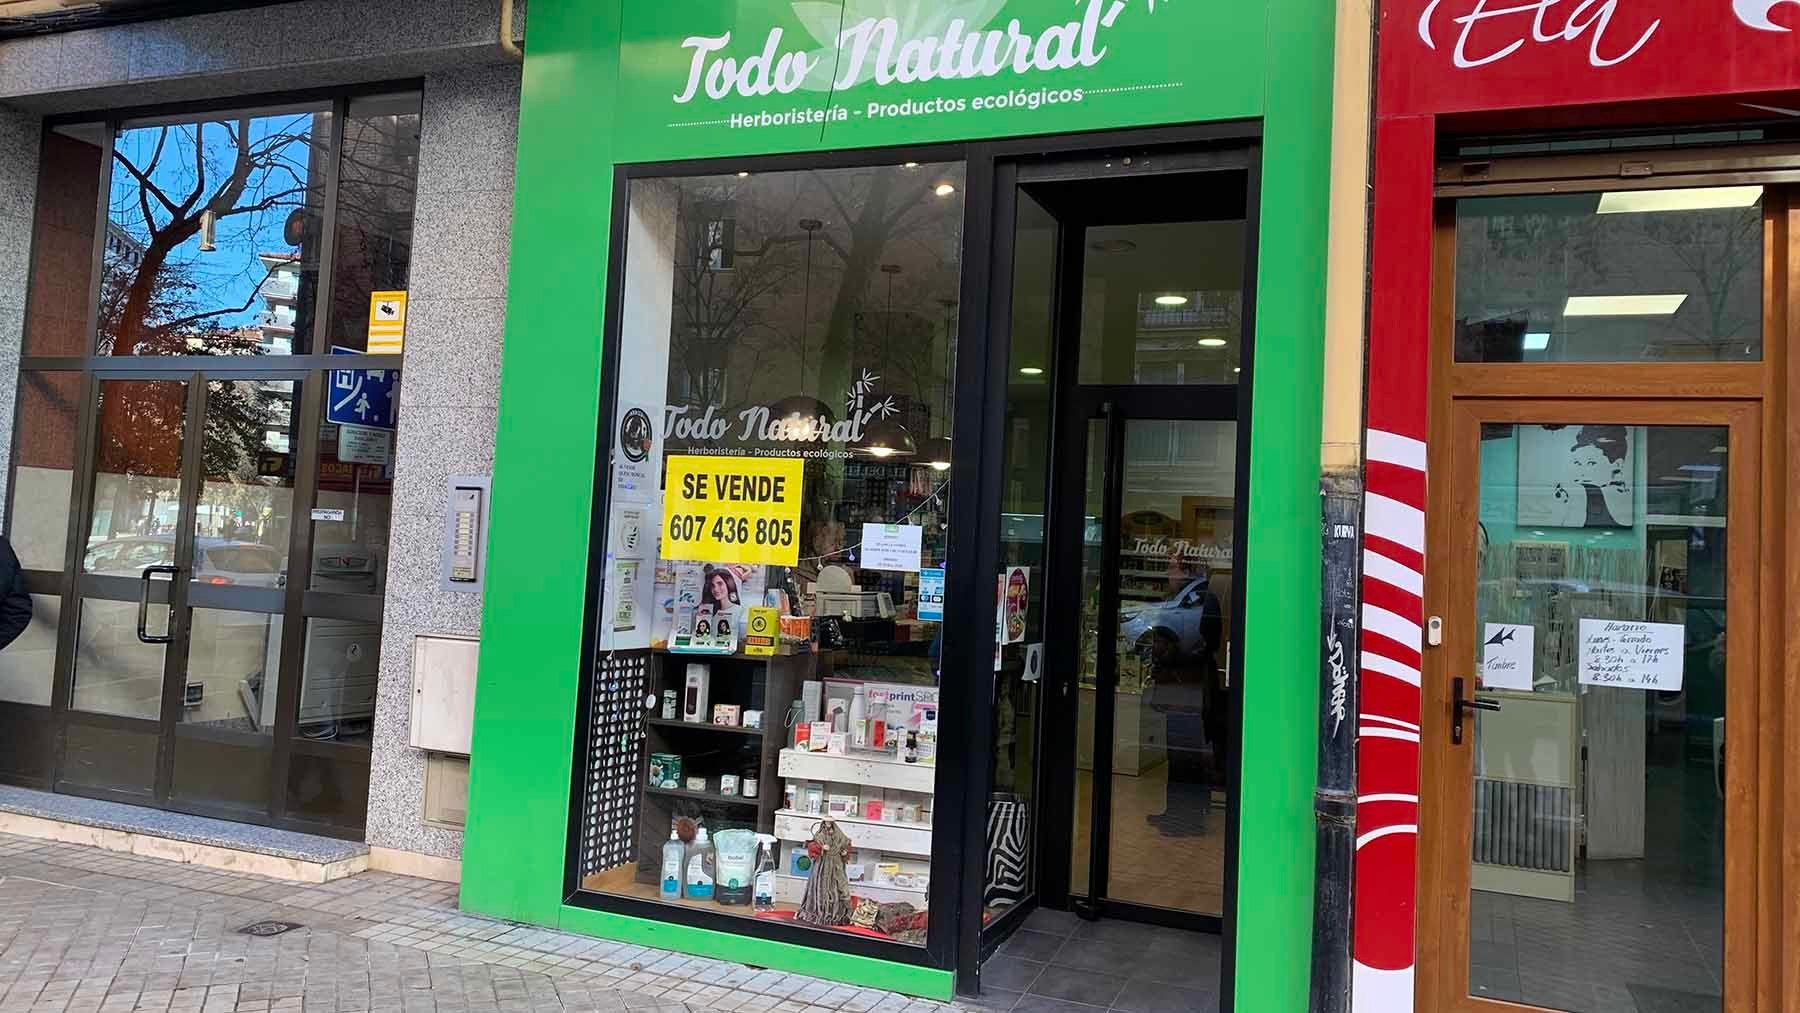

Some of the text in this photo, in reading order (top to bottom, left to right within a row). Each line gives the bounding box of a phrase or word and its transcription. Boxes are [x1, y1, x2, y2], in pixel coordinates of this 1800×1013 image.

[672, 0, 1107, 104] Todo Natural
[730, 105, 849, 129] Herboristería
[867, 98, 966, 119] Productos
[972, 88, 1083, 111] ecológicos
[662, 404, 864, 443] Todo Natural
[687, 446, 746, 456] Herboristería
[755, 447, 801, 458] Productos
[803, 448, 854, 460] ecológicos
[682, 473, 785, 503] SE VENDE
[670, 514, 793, 546] 607 436 805
[1133, 538, 1233, 559] Todo Natura
